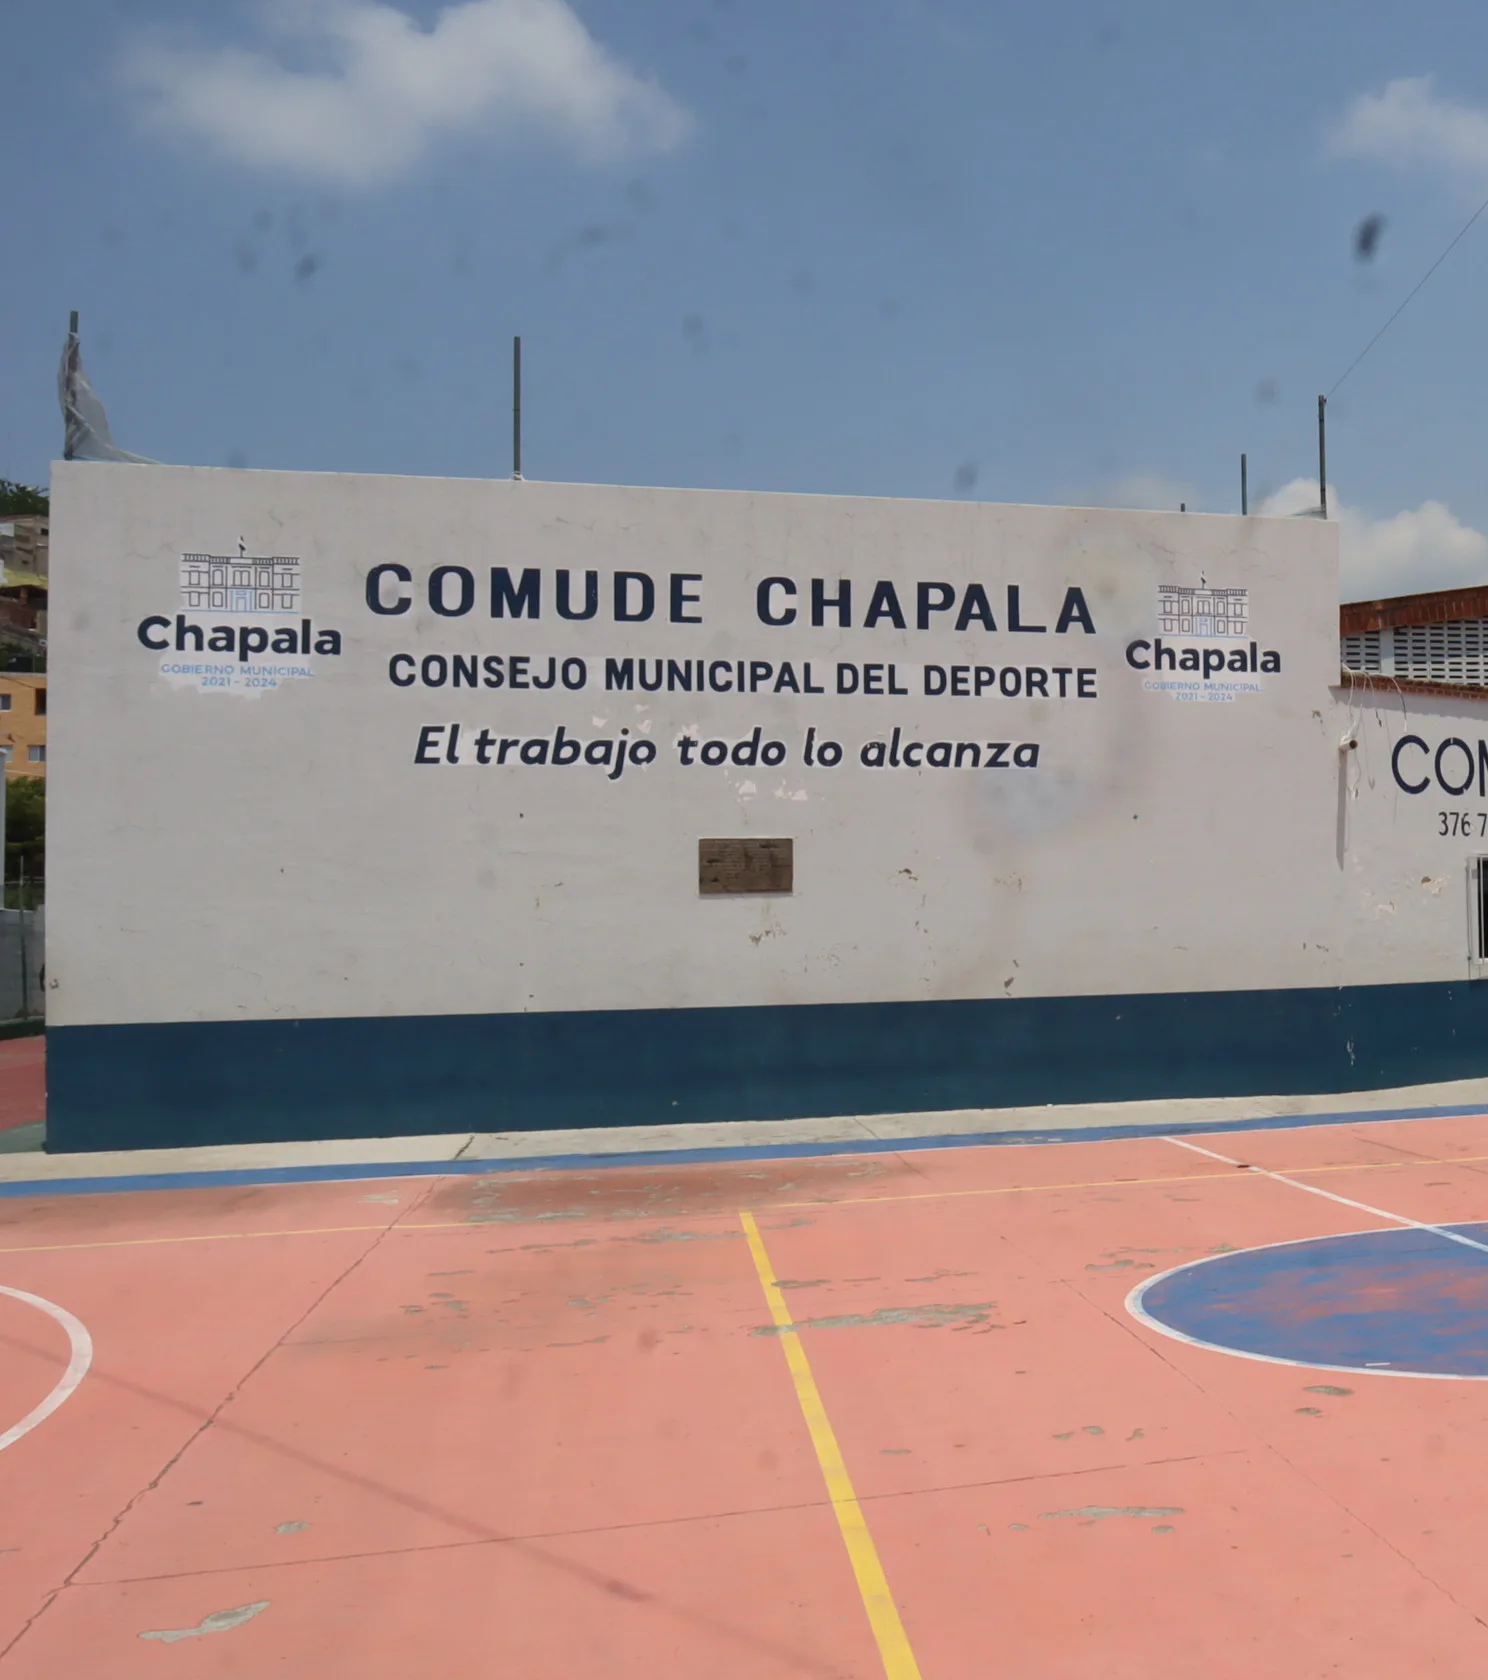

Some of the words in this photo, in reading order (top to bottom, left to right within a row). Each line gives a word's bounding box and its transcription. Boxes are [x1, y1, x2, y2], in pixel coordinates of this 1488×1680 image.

[365, 563, 703, 623] COMUDE
[756, 577, 1097, 634] CHAPALA
[137, 614, 341, 662] Chapala
[160, 663, 234, 675] GOBIERNO
[239, 665, 316, 678] MUNICIPAL
[388, 654, 587, 690] CONSEJO
[605, 657, 824, 694] MUNICIPAL
[836, 663, 908, 695] DEL
[924, 665, 1097, 698] DEPORTE
[1125, 638, 1281, 680] Chapala
[201, 676, 231, 687] 2021
[244, 677, 278, 688] 2024
[1144, 681, 1200, 691] GOBIERNO
[1203, 682, 1264, 692] MUNICIPAL
[1175, 692, 1198, 701] 2021
[1208, 692, 1233, 701] 2024
[414, 723, 461, 765] El
[474, 725, 657, 781] trabajo
[678, 726, 786, 767] todo
[803, 727, 843, 767] lo
[860, 727, 1040, 768] alcanza
[1438, 811, 1471, 837] 376
